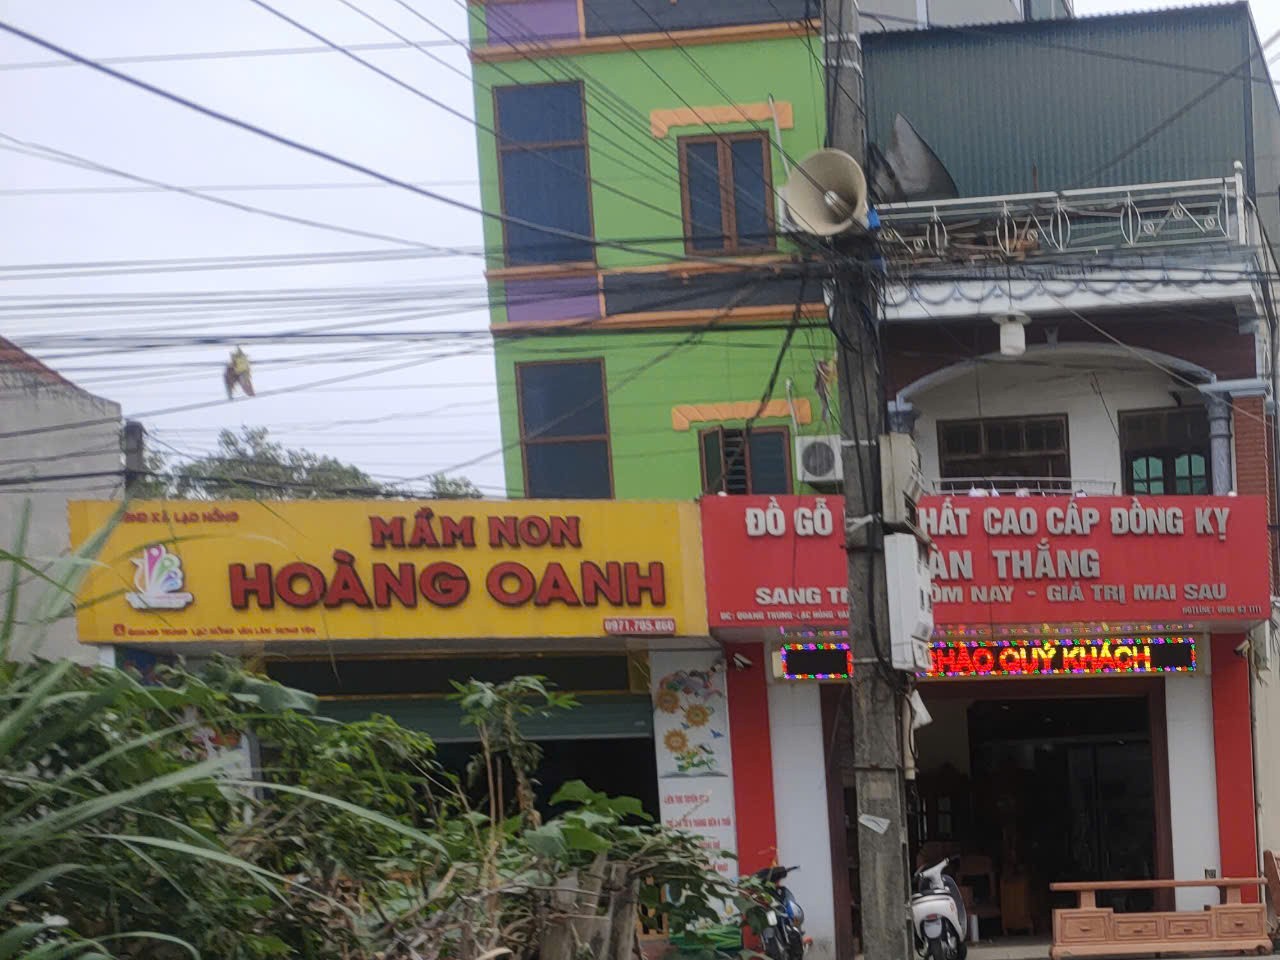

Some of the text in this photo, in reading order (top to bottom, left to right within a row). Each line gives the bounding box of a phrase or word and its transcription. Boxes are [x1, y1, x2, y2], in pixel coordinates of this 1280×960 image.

[487, 514, 582, 549] NON
[744, 496, 786, 537] ĐỒ
[793, 497, 834, 537] GỖ
[915, 497, 971, 536] HẤT
[983, 507, 1038, 536] CAO
[1046, 496, 1100, 536] CẤP
[1110, 496, 1185, 536] ĐỒNG
[928, 538, 1101, 580] ÀN THẮNG
[228, 550, 667, 610] HOÀNG OANH
[755, 587, 822, 605] SANG
[930, 583, 964, 603] ÔM
[970, 584, 1014, 603] NAY
[1046, 581, 1085, 602] GIÁ
[1090, 583, 1126, 604] TRỊ
[1133, 583, 1178, 601] MAI
[1184, 583, 1228, 601] SAU
[999, 643, 1057, 673] QUÝ
[1062, 642, 1151, 671] KHÁCH
